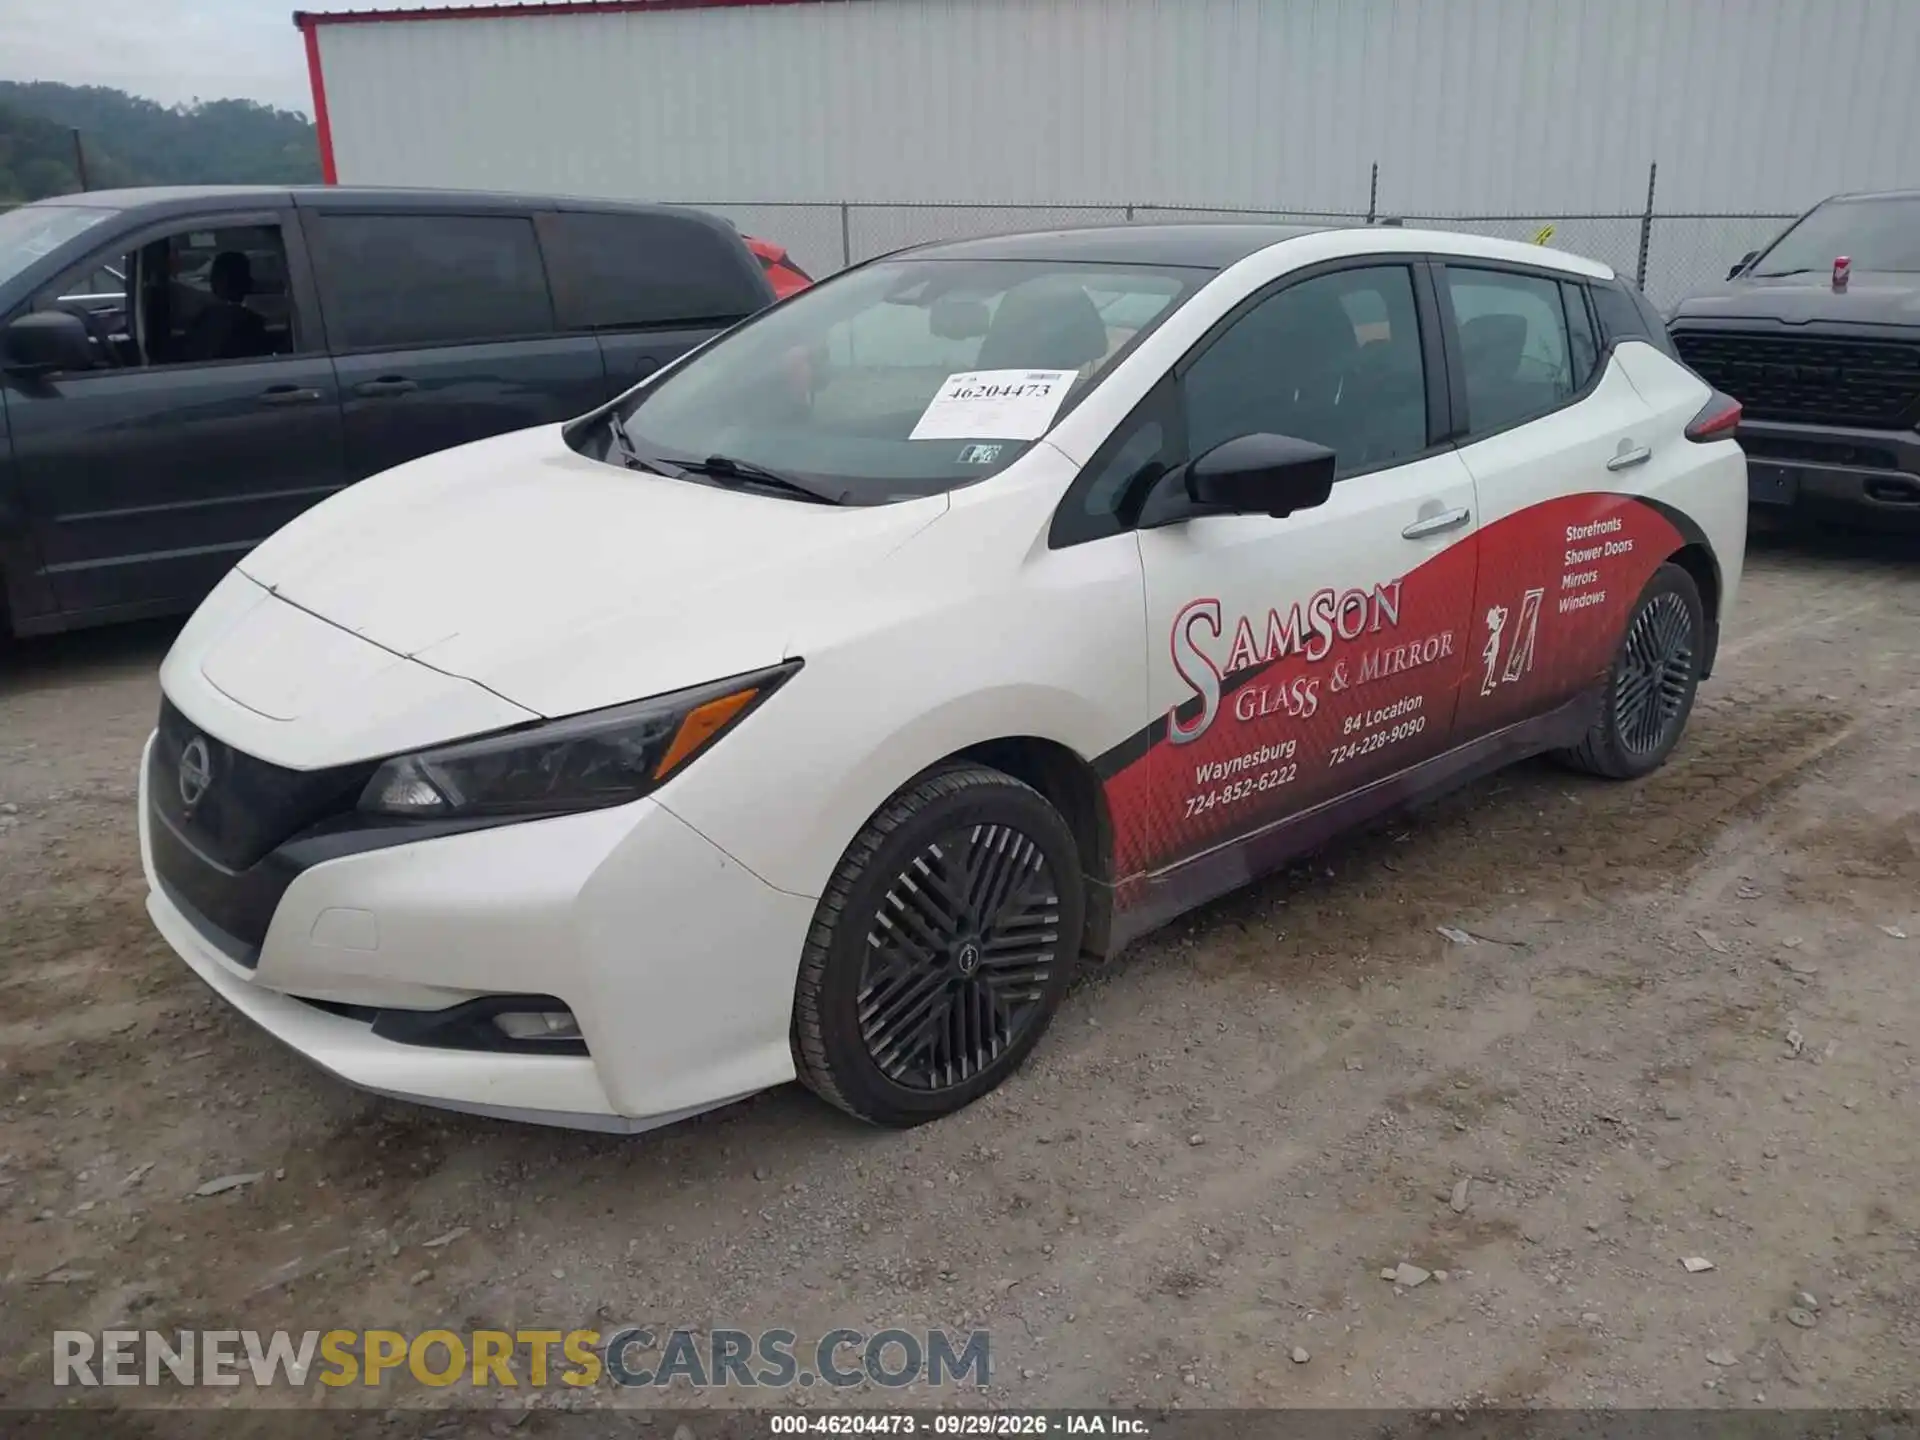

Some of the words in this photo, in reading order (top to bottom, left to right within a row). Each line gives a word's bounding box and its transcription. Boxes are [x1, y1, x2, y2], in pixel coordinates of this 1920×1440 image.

[948, 384, 1051, 399] 46204473
[1565, 516, 1622, 542] Storefronts
[1564, 547, 1602, 566] Shower
[1604, 538, 1633, 557] Doors
[1561, 568, 1598, 590] Mirrors
[1558, 590, 1606, 613] Windows
[1168, 579, 1404, 744] SAMSON
[1235, 674, 1321, 722] GLASS
[1330, 658, 1350, 693] &
[1356, 629, 1454, 685] MIRROR
[1343, 711, 1362, 735] 84
[1365, 695, 1423, 729] Location
[1195, 738, 1297, 785] Waynesburg
[1328, 716, 1426, 768] 724-228-9090
[1184, 763, 1298, 819] 724-852-6222
